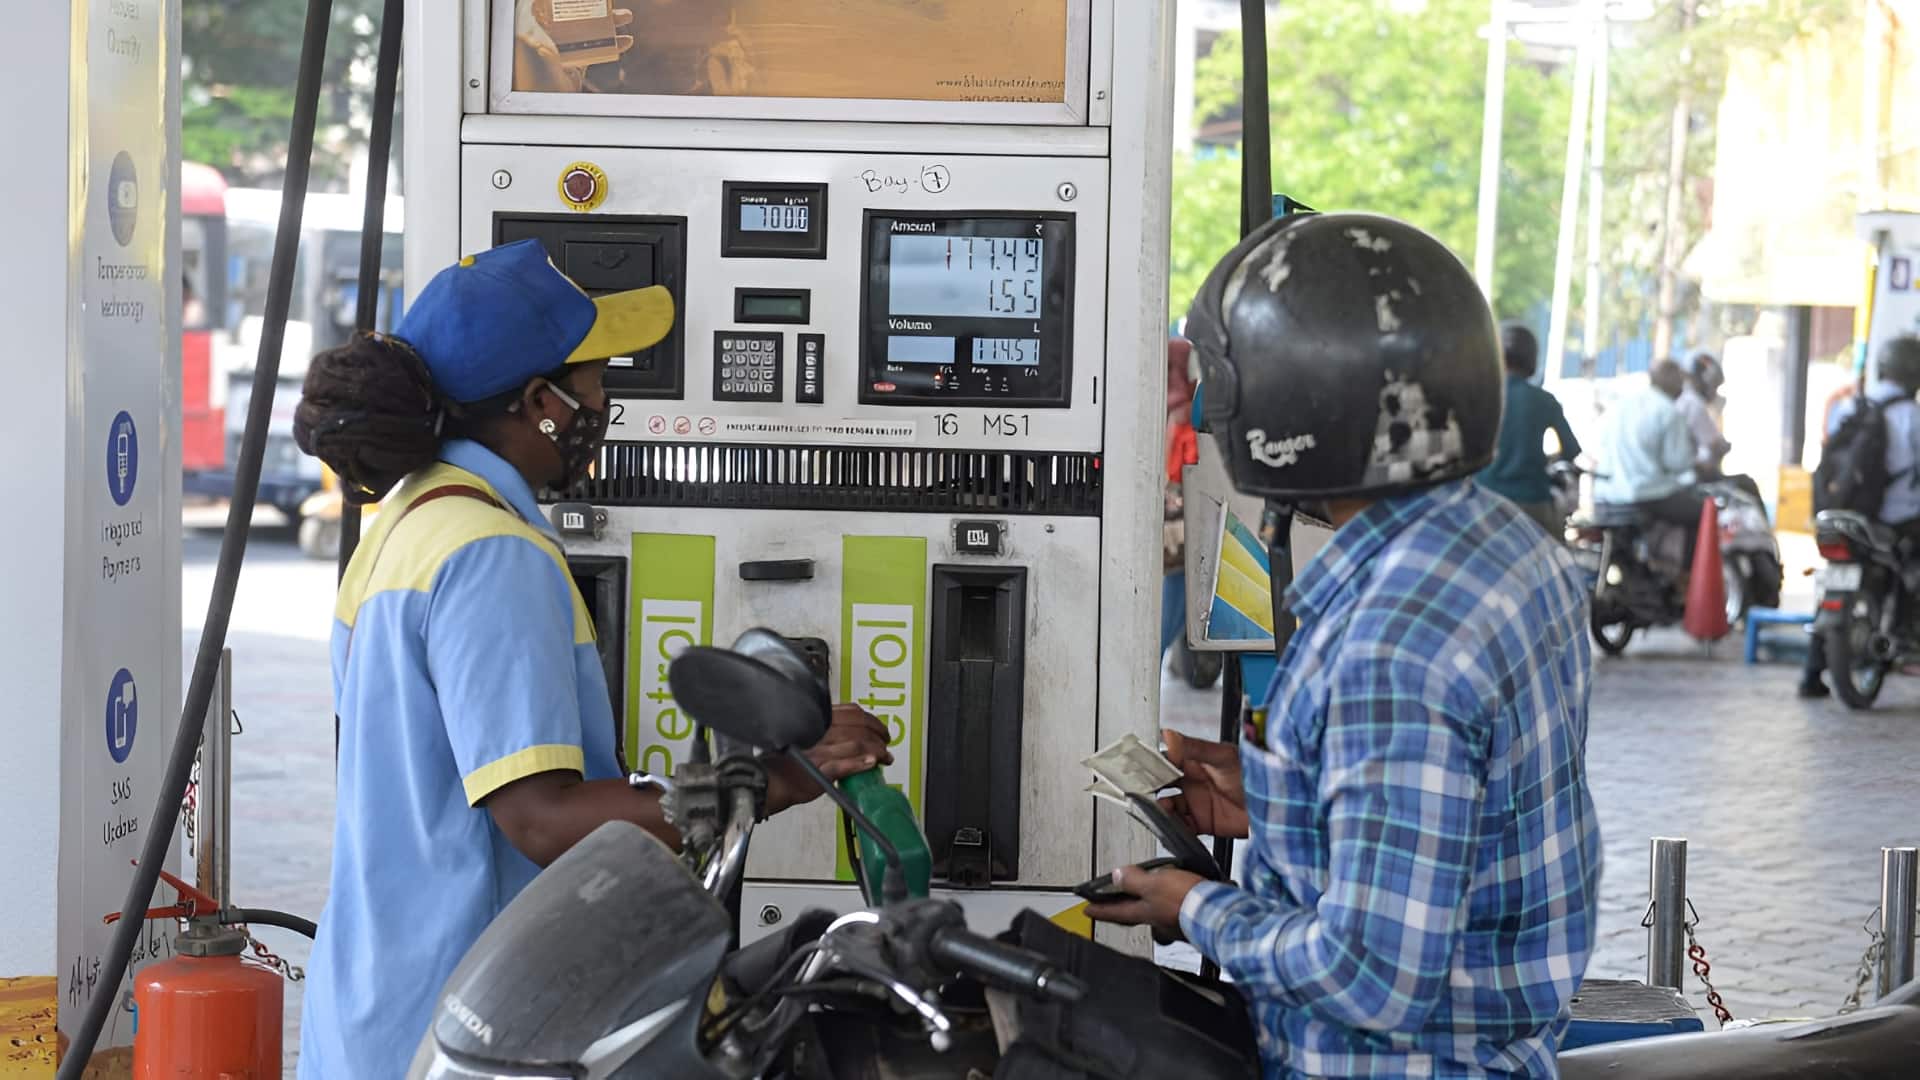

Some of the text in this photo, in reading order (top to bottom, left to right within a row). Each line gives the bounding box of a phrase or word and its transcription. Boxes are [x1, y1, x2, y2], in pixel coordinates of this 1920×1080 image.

[890, 220, 936, 232] Amount
[946, 238, 1039, 273] 177.49
[989, 279, 1038, 313] 1.55
[888, 319, 1040, 333] Volume L
[979, 338, 1039, 362] 114.51
[933, 413, 959, 436] 16
[983, 414, 1029, 436] MS1
[856, 620, 907, 793] etrol
